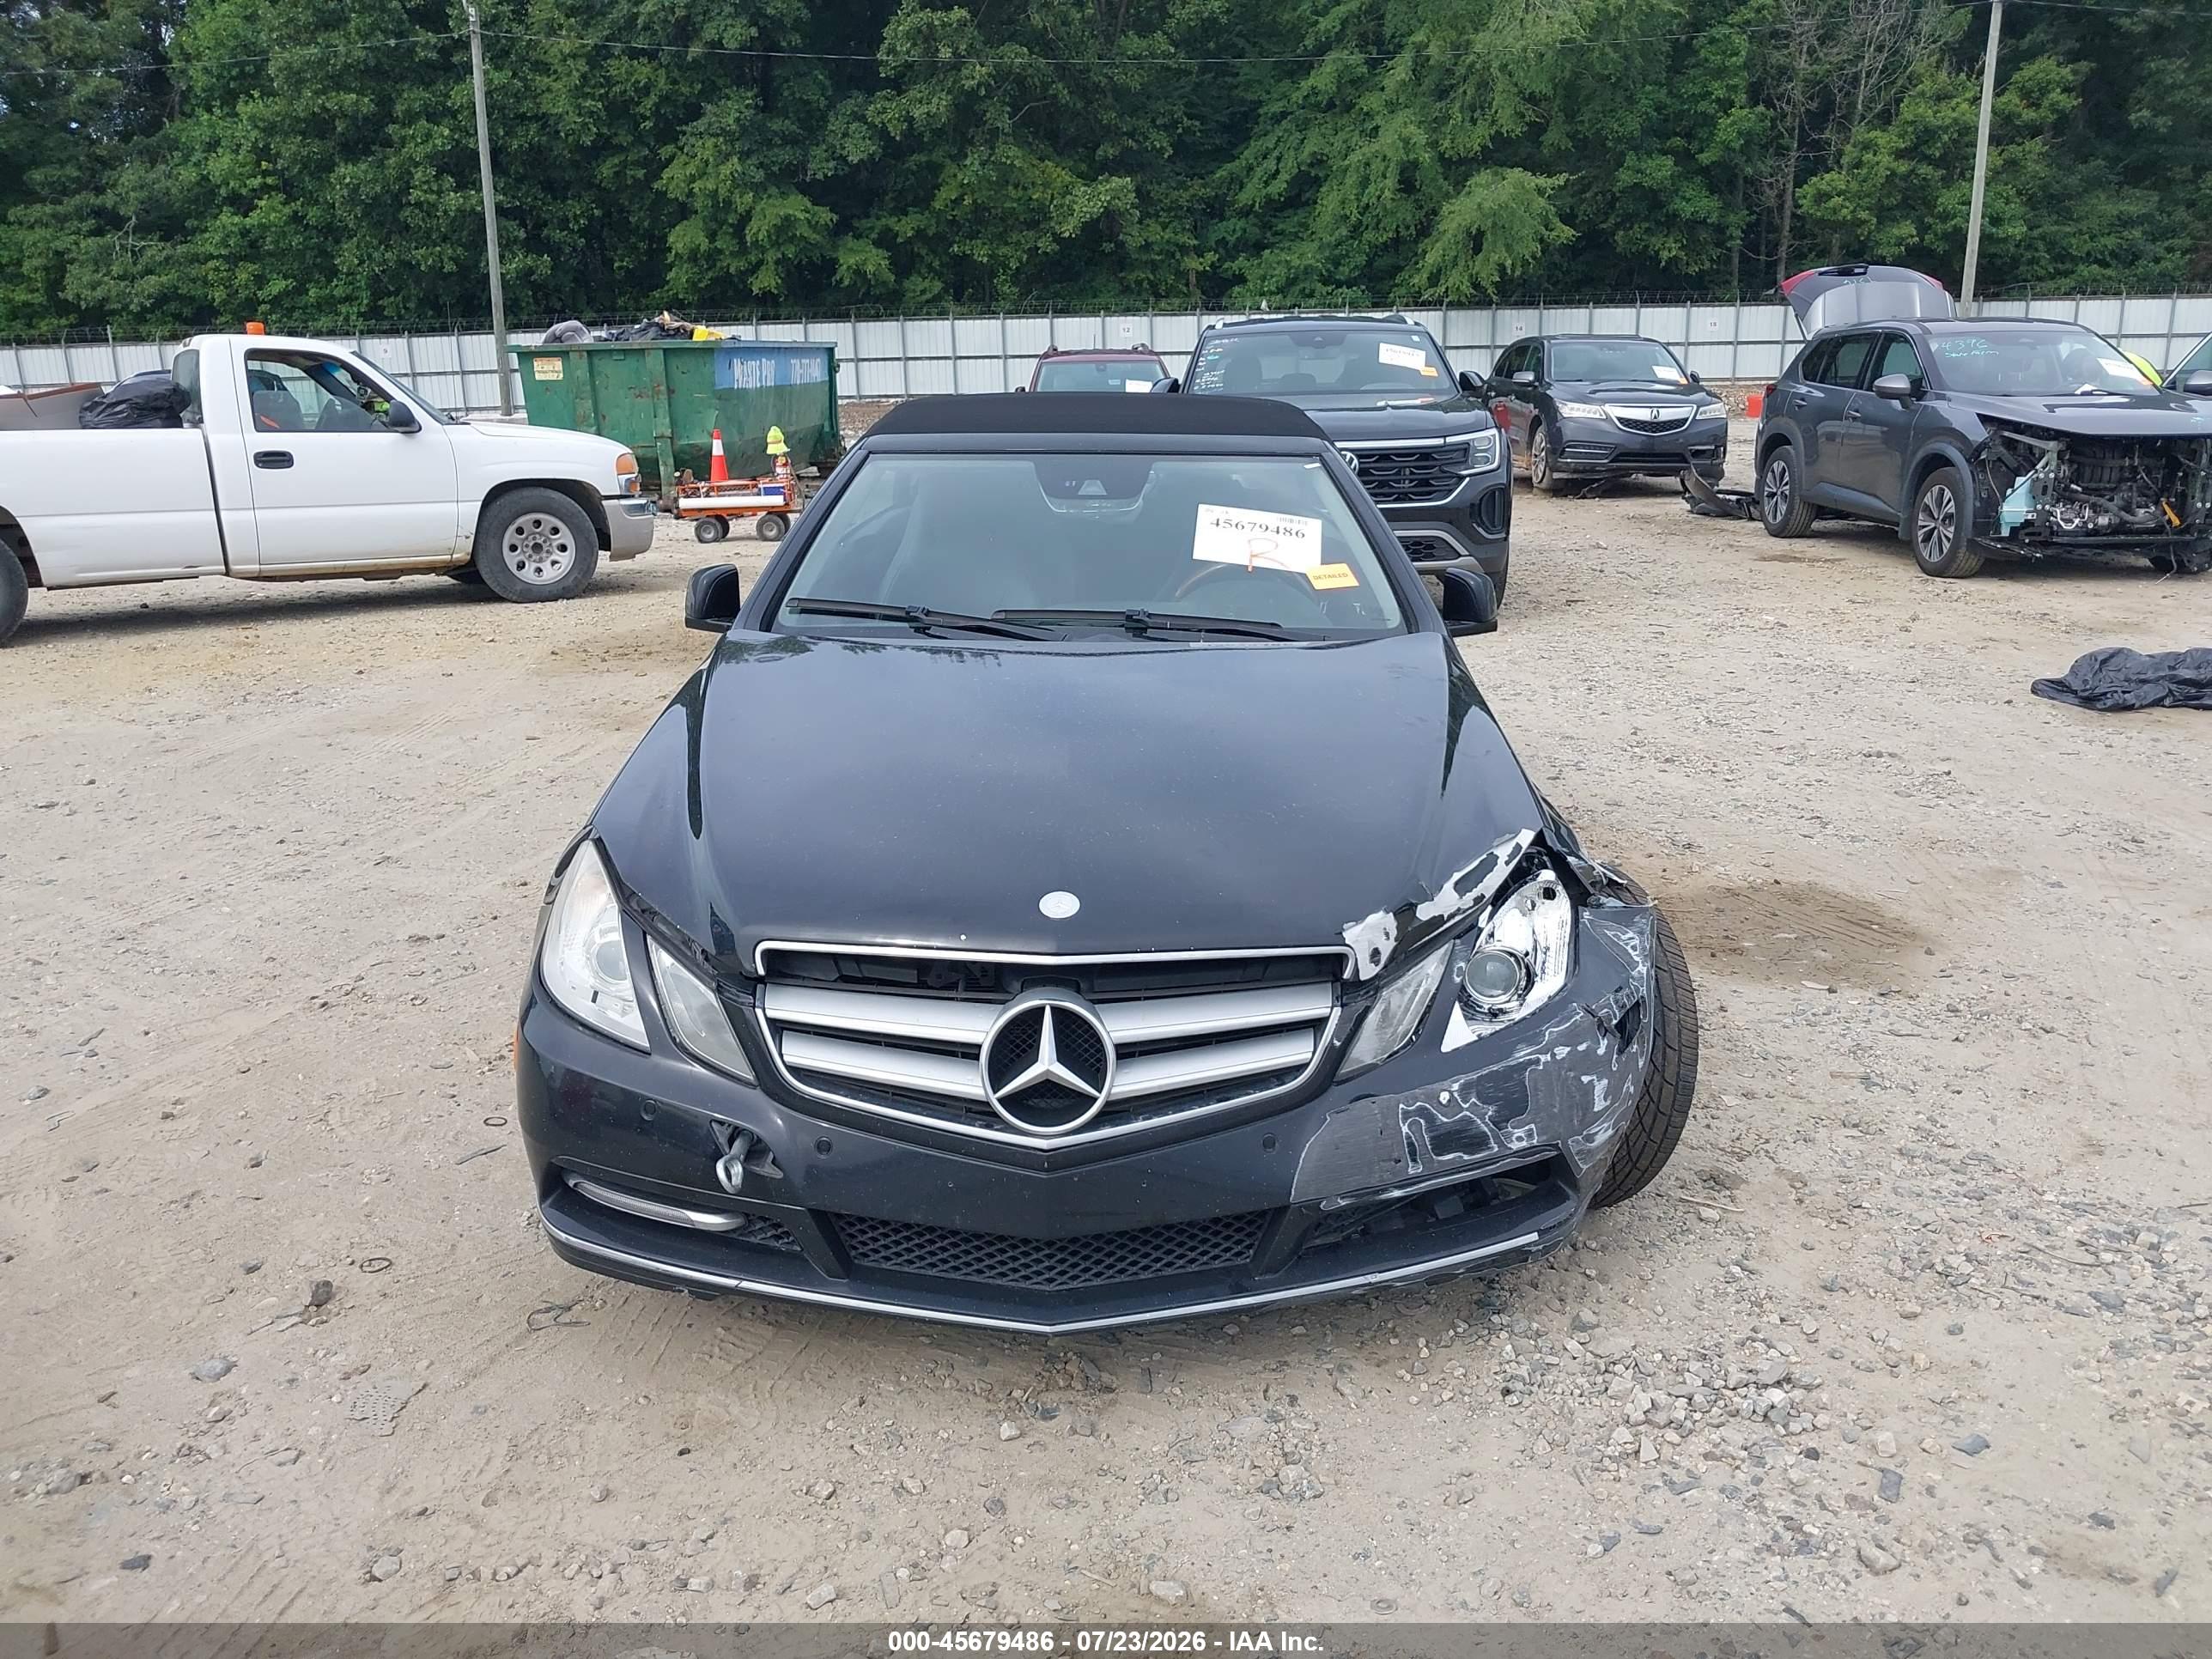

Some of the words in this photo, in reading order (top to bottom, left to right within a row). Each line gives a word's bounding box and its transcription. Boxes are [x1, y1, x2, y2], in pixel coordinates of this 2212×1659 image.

[733, 357, 760, 390] WASTE
[1210, 518, 1305, 538] 45679486
[1312, 572, 1348, 580] DETAILED
